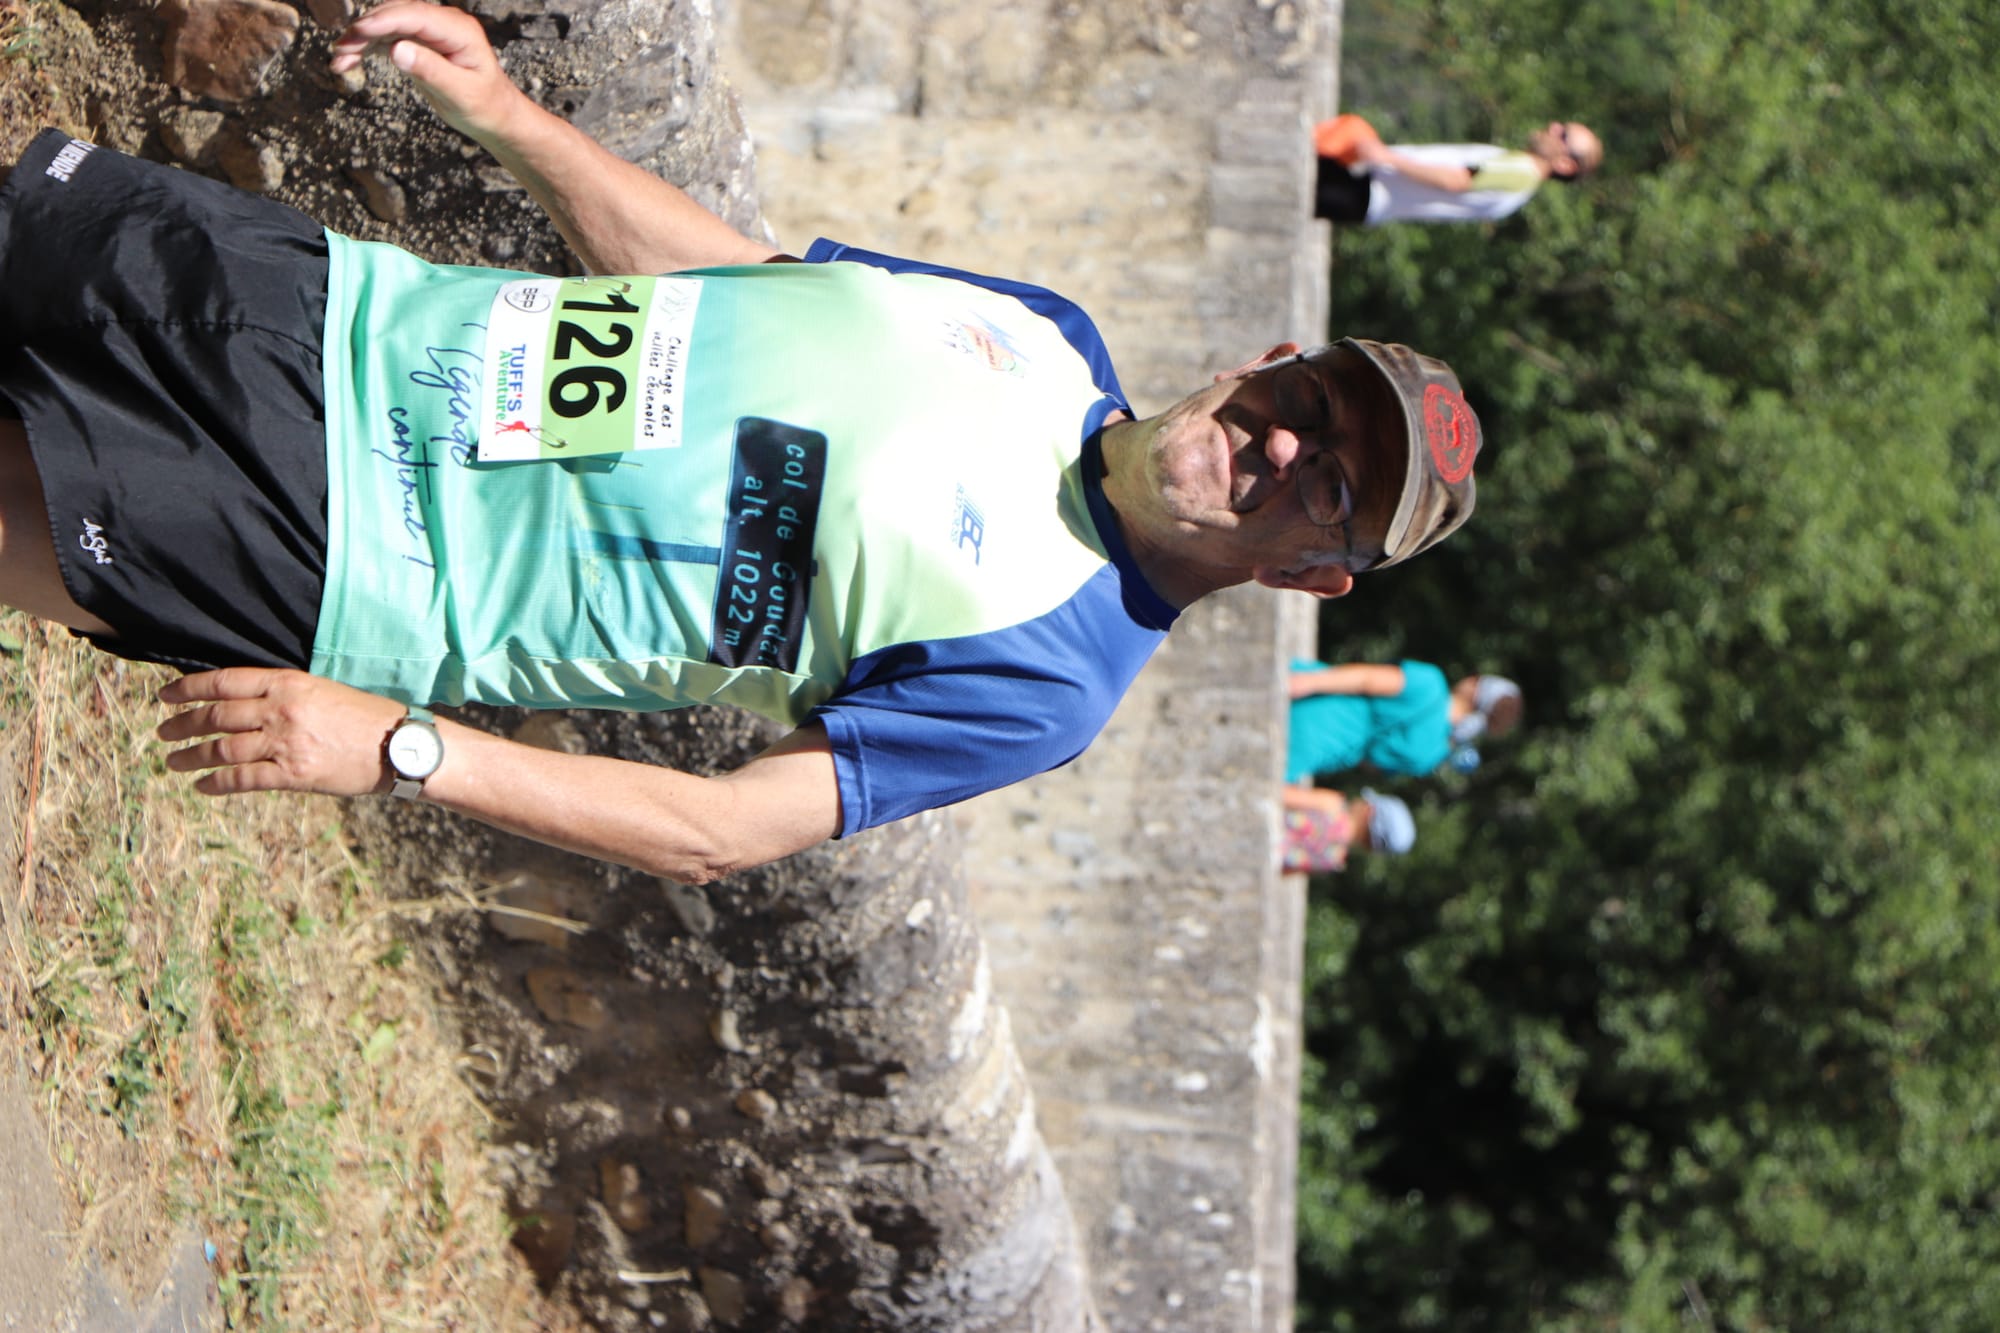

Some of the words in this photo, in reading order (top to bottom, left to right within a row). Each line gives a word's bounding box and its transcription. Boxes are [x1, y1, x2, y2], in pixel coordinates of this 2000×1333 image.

[45, 143, 88, 182] MENDE
[548, 293, 640, 418] 126
[649, 331, 664, 368] vallées
[659, 337, 682, 395] Challenge
[495, 350, 513, 421] Aventure
[507, 344, 526, 411] TUFF'S
[644, 376, 660, 438] cévenoles
[661, 404, 675, 429] des
[782, 443, 808, 489] col
[739, 475, 768, 525] alt.
[776, 506, 802, 541] de
[728, 549, 763, 624] 1022
[724, 627, 741, 647] m
